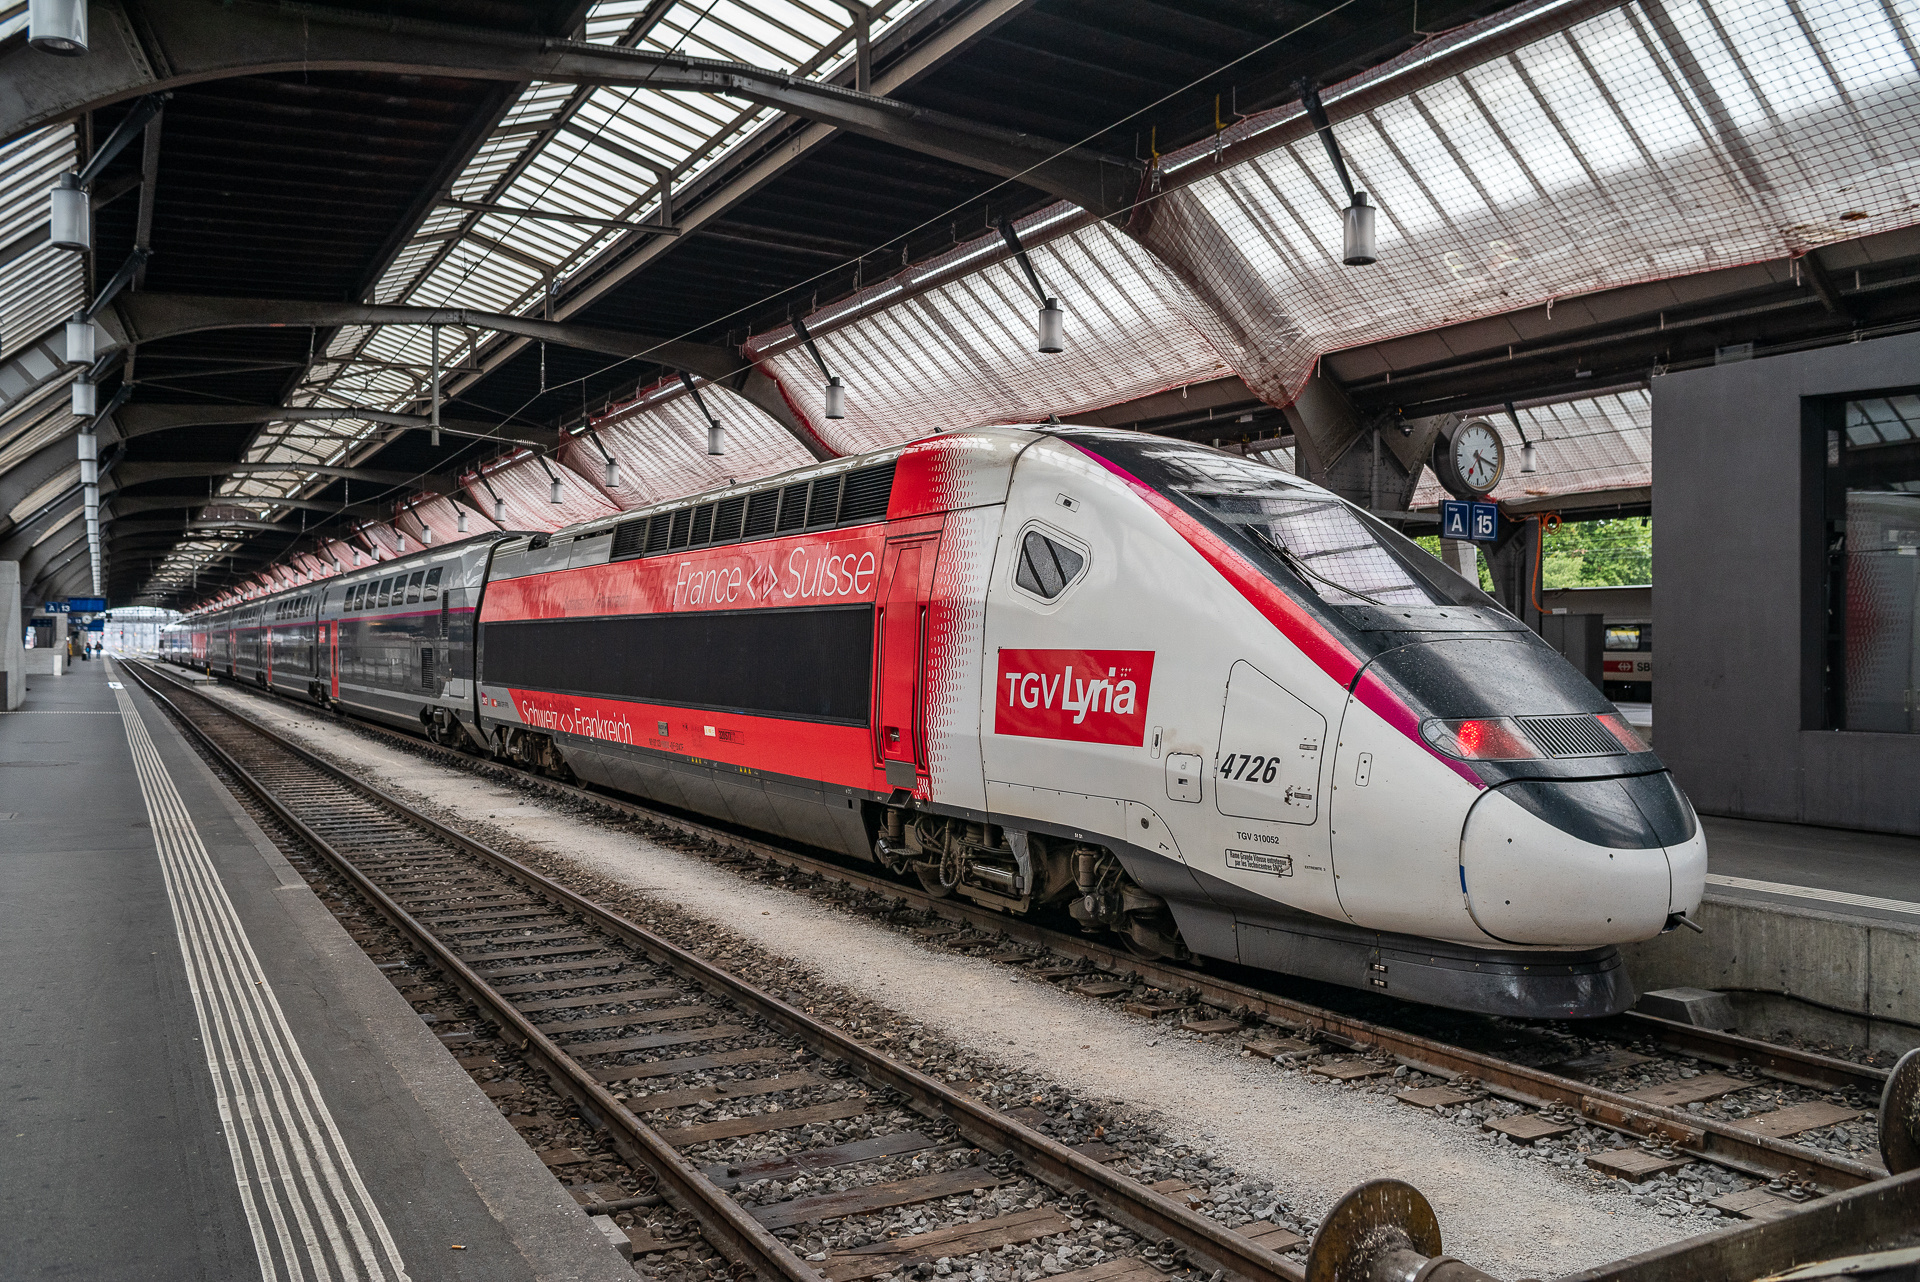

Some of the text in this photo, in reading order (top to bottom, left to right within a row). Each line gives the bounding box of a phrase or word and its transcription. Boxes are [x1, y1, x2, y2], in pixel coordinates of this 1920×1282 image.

[1451, 513, 1463, 532] A
[1477, 515, 1493, 534] 15
[673, 561, 742, 606] France
[783, 542, 876, 599] Suisse
[1637, 662, 1652, 672] SB
[1005, 666, 1137, 725] TGV Lyria
[522, 700, 558, 730] Schweiz
[574, 708, 633, 745] Frankreich
[1220, 753, 1281, 784] 4726
[1237, 831, 1280, 845] TGV 310052
[1240, 852, 1253, 861] Grande
